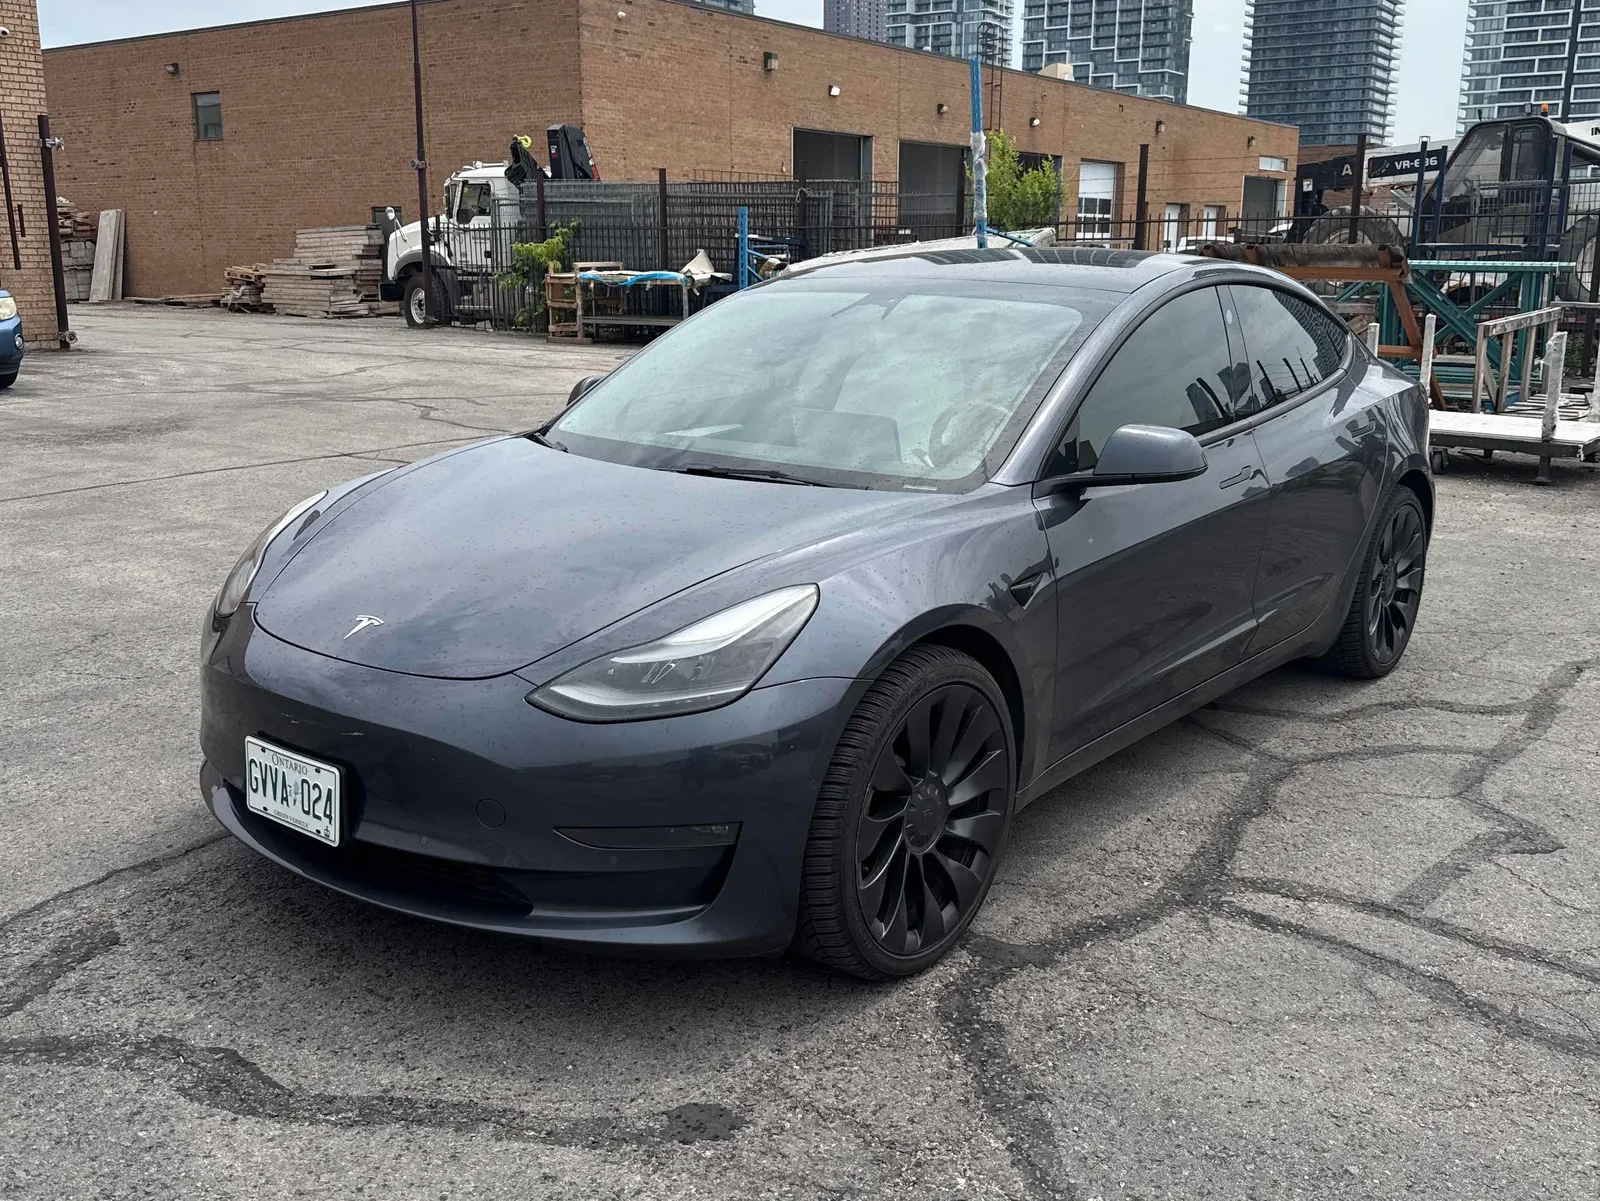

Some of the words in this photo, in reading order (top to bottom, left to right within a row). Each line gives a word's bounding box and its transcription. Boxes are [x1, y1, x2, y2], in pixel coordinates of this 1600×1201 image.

[1342, 163, 1353, 176] A
[249, 758, 290, 808] GVVA
[300, 777, 333, 826] 024
